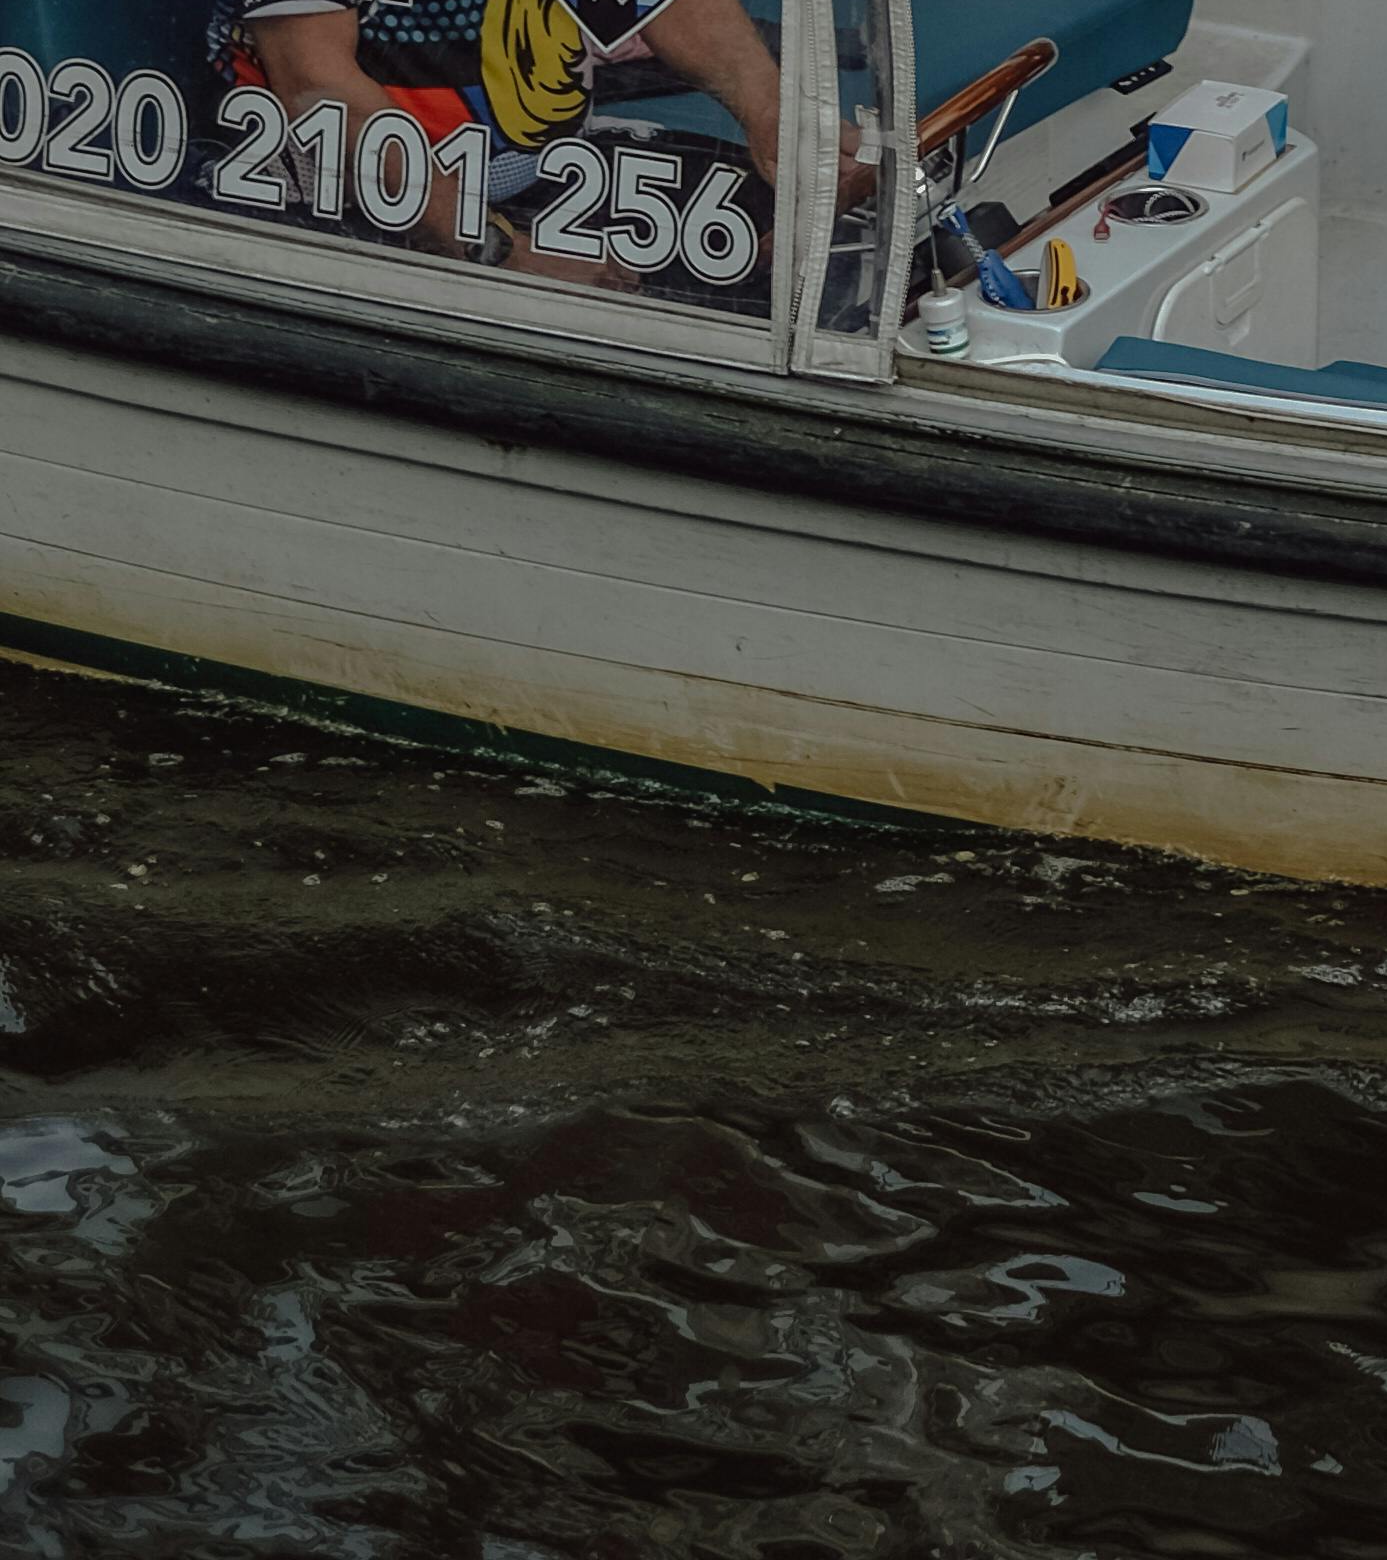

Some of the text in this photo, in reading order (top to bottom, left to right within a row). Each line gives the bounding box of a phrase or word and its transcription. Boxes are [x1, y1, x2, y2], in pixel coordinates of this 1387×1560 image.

[0, 46, 759, 285] 020 2101 256
